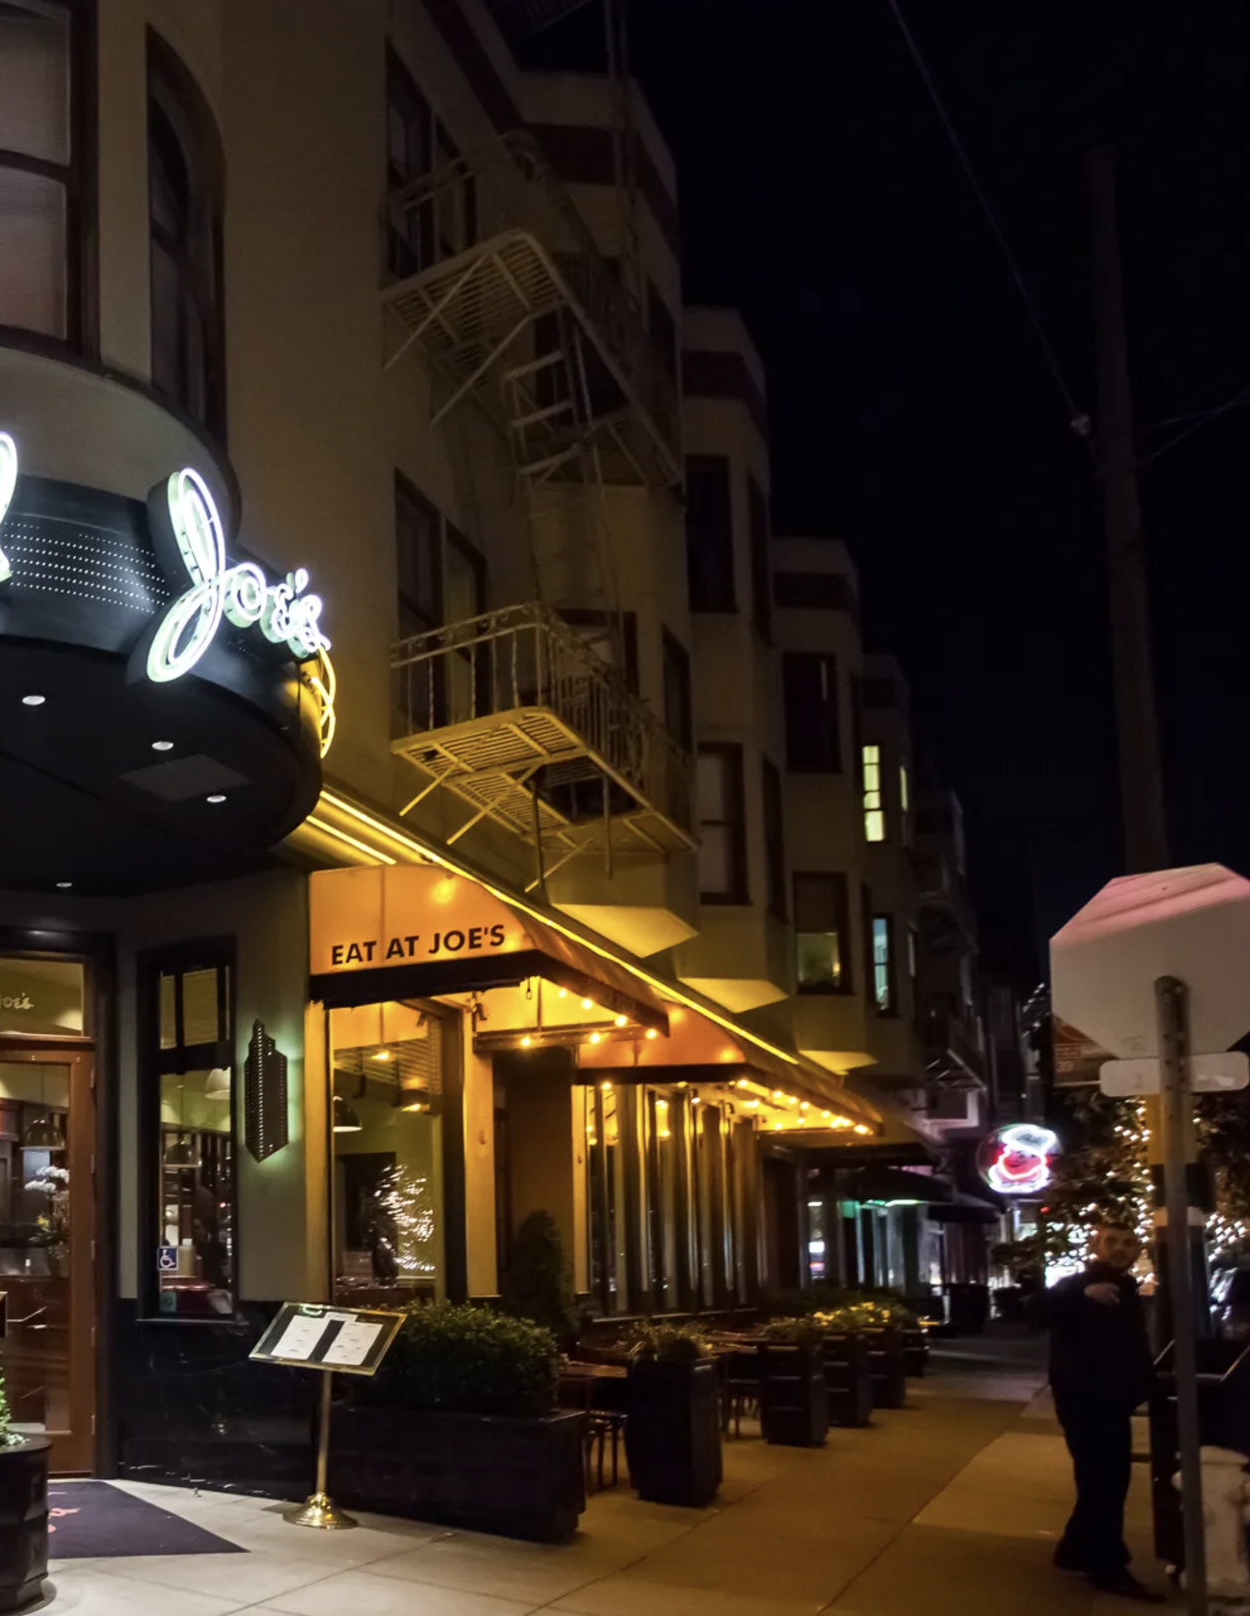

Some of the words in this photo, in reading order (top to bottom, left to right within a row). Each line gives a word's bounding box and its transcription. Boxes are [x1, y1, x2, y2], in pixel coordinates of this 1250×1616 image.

[146, 466, 331, 683] Joe's
[330, 940, 377, 965] EAT
[385, 935, 420, 960] AT
[427, 924, 506, 954] JOE'S
